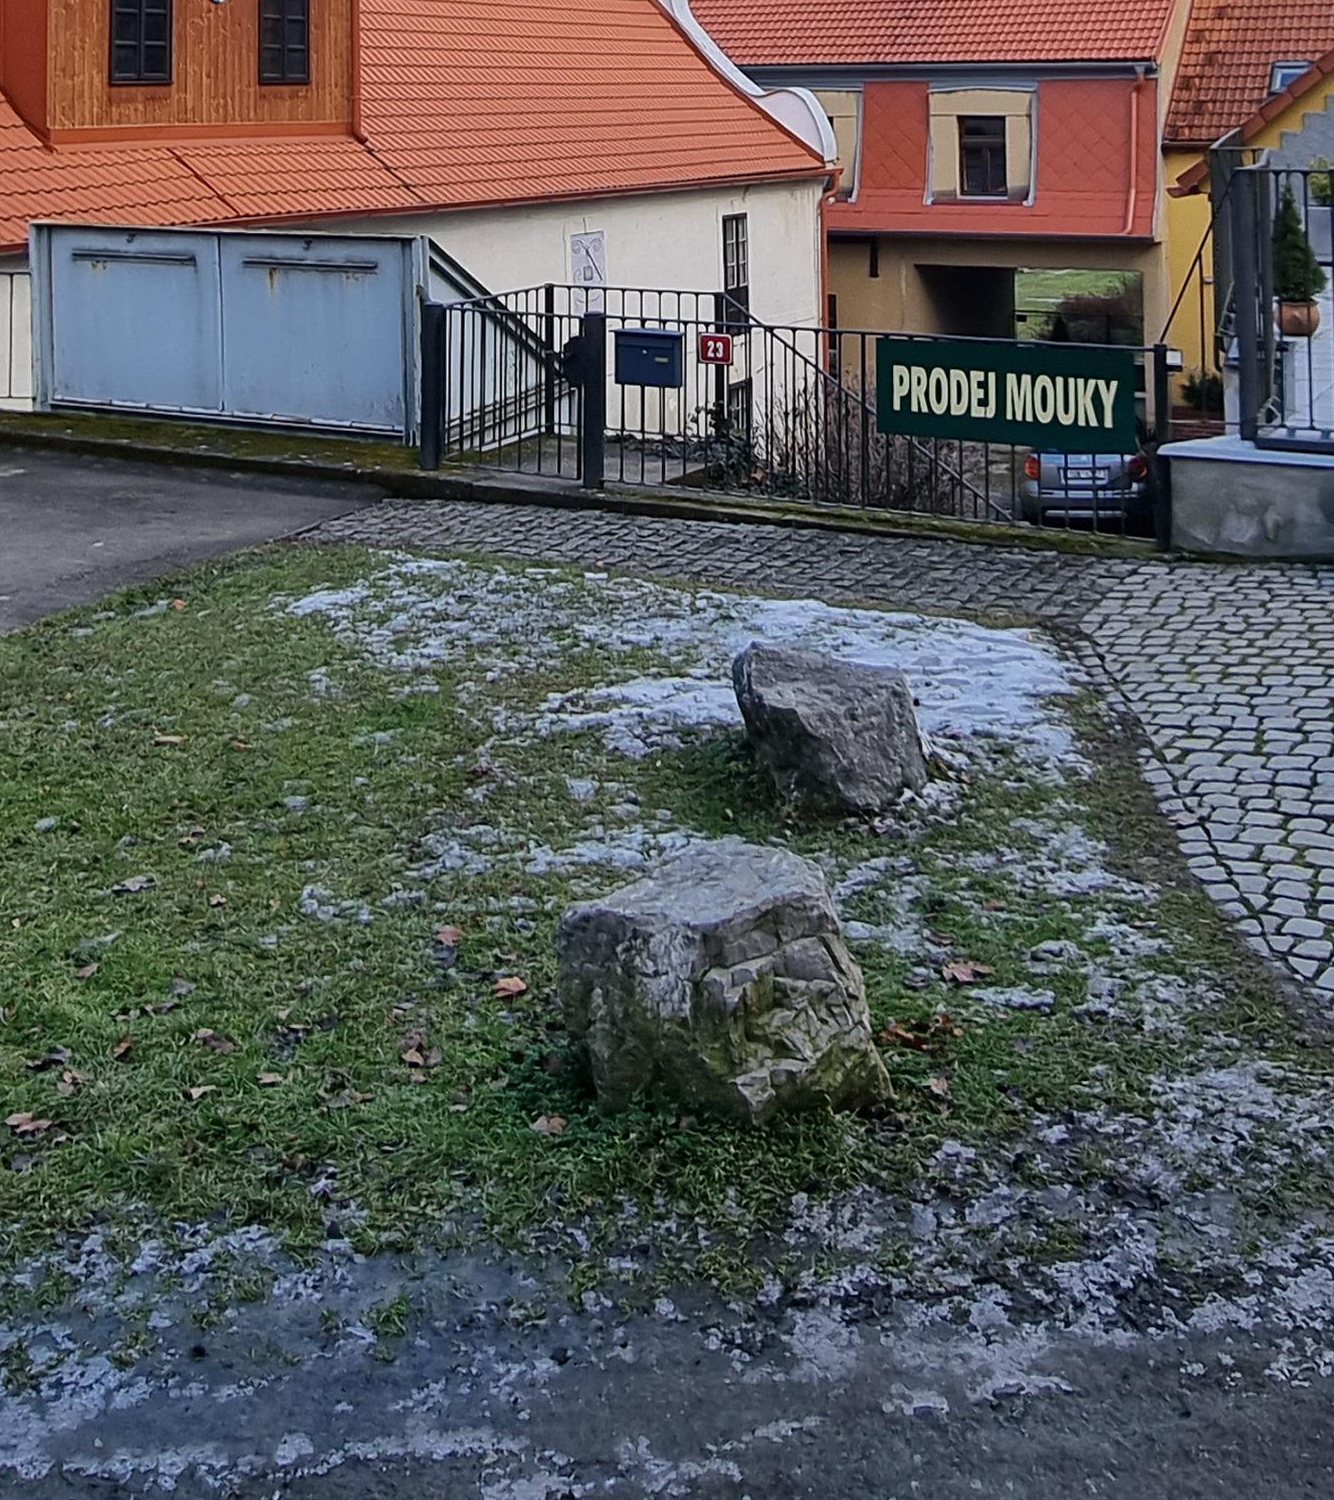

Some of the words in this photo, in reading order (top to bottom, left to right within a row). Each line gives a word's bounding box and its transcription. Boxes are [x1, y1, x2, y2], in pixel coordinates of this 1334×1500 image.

[707, 340, 724, 358] 23
[892, 364, 996, 418] PRODEJ
[1005, 372, 1118, 428] MOUKY
